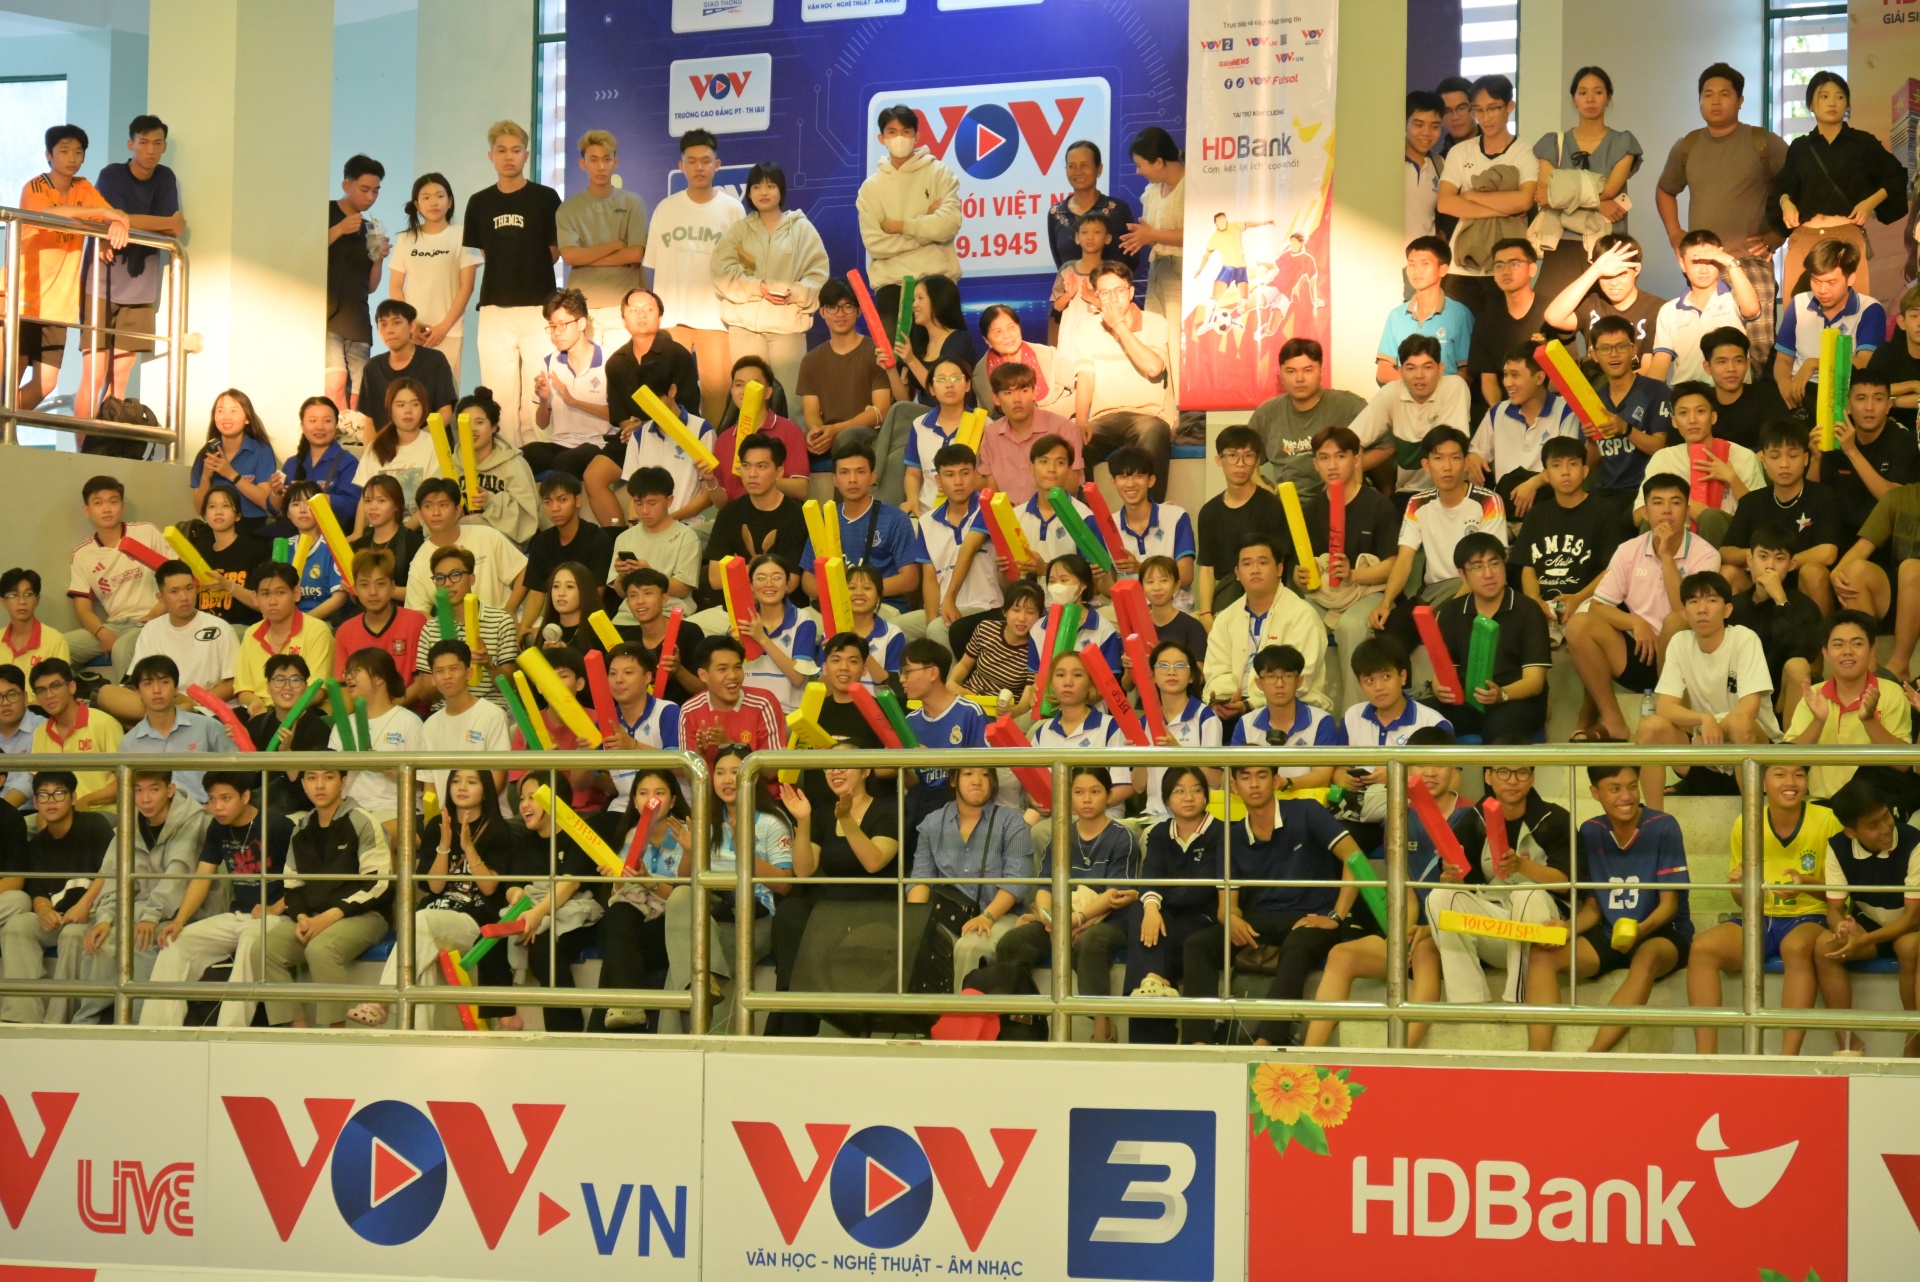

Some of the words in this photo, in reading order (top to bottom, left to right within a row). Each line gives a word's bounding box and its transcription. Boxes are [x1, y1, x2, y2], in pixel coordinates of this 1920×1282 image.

[1883, 10, 1905, 24] GIẢI
[1301, 29, 1324, 39] VOV
[1201, 41, 1221, 49] VOV
[1246, 37, 1269, 47] VOV
[1275, 52, 1294, 63] VOV
[689, 71, 752, 101] VOV
[1272, 74, 1298, 85] Futsal
[675, 110, 700, 119] TRƯỜNG
[1202, 132, 1292, 160] HDBank
[960, 193, 985, 218] ÓI
[992, 190, 1041, 219] VIỆT
[493, 214, 524, 229] THEMES
[299, 586, 321, 597] ates
[1608, 876, 1640, 909] 23
[1461, 915, 1480, 930] TÔI
[221, 1096, 566, 1250] VOV
[580, 1182, 687, 1259] VN
[731, 1121, 1038, 1252] VOV
[1089, 1140, 1197, 1244] 3
[77, 1159, 194, 1237] LIVE
[1352, 1156, 1696, 1247] HDBank
[746, 1248, 777, 1267] VĂN
[781, 1253, 816, 1272] HỌC
[833, 1252, 877, 1275] NGHỆ
[881, 1254, 931, 1277] THUẬT
[948, 1255, 973, 1275] ÂM
[977, 1261, 1023, 1280] NHẠC
